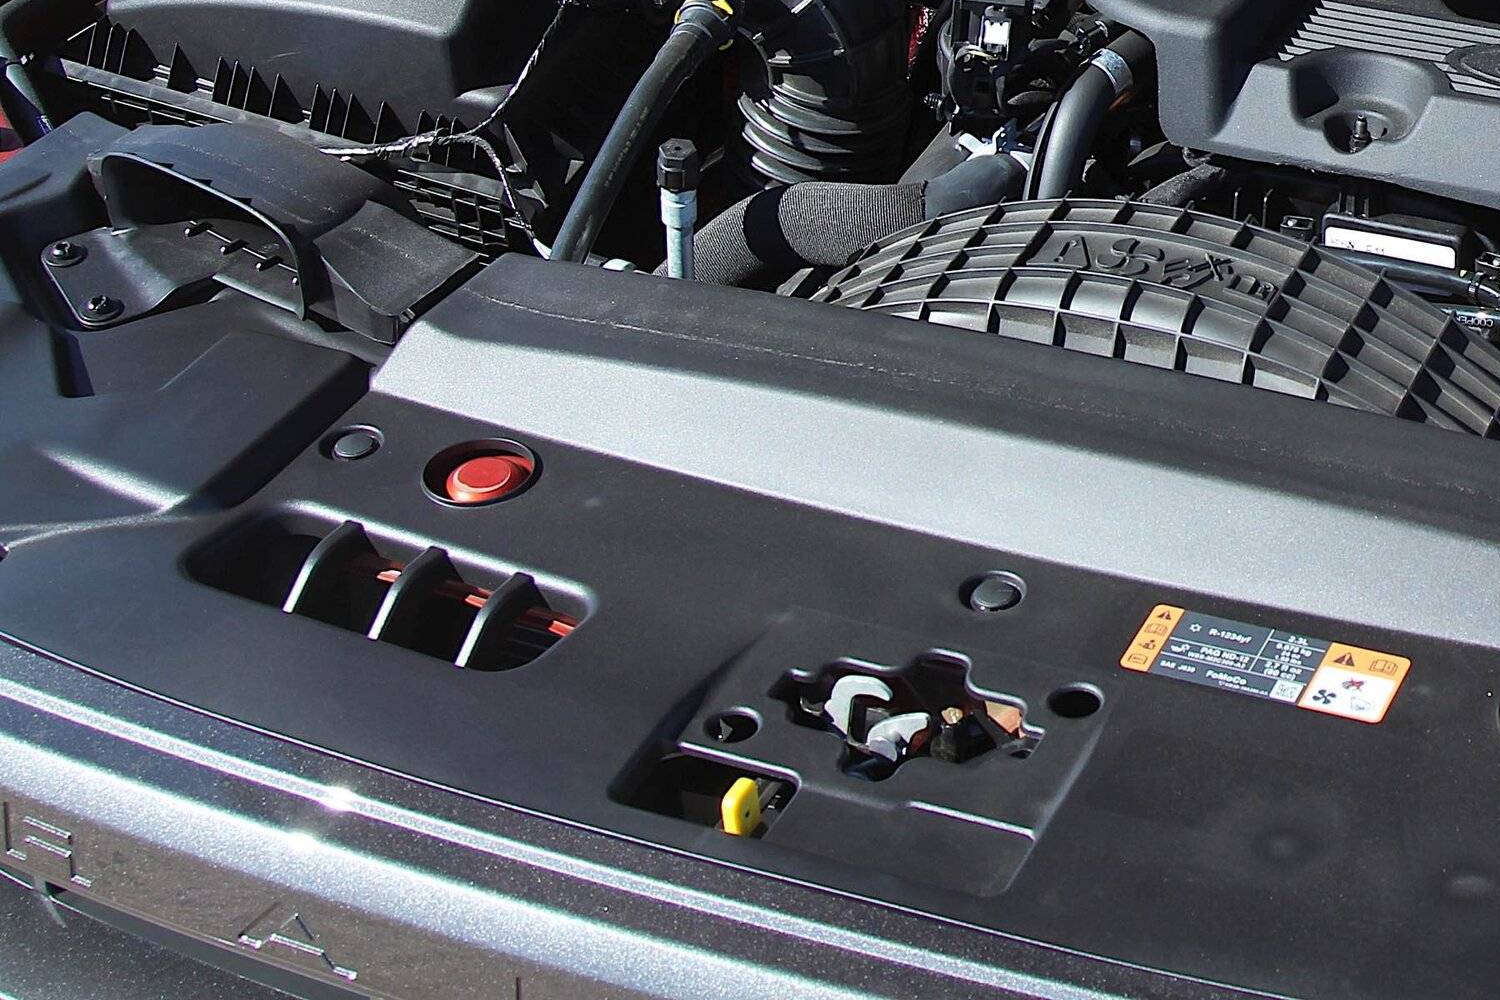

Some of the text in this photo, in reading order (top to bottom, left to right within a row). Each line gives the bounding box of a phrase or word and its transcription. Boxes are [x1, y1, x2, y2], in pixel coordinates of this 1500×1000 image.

[1208, 628, 1252, 644] R-1234yf
[1288, 635, 1309, 646] 2.3L
[1221, 651, 1250, 663] ND-12
[1205, 670, 1248, 686] FoMoCo
